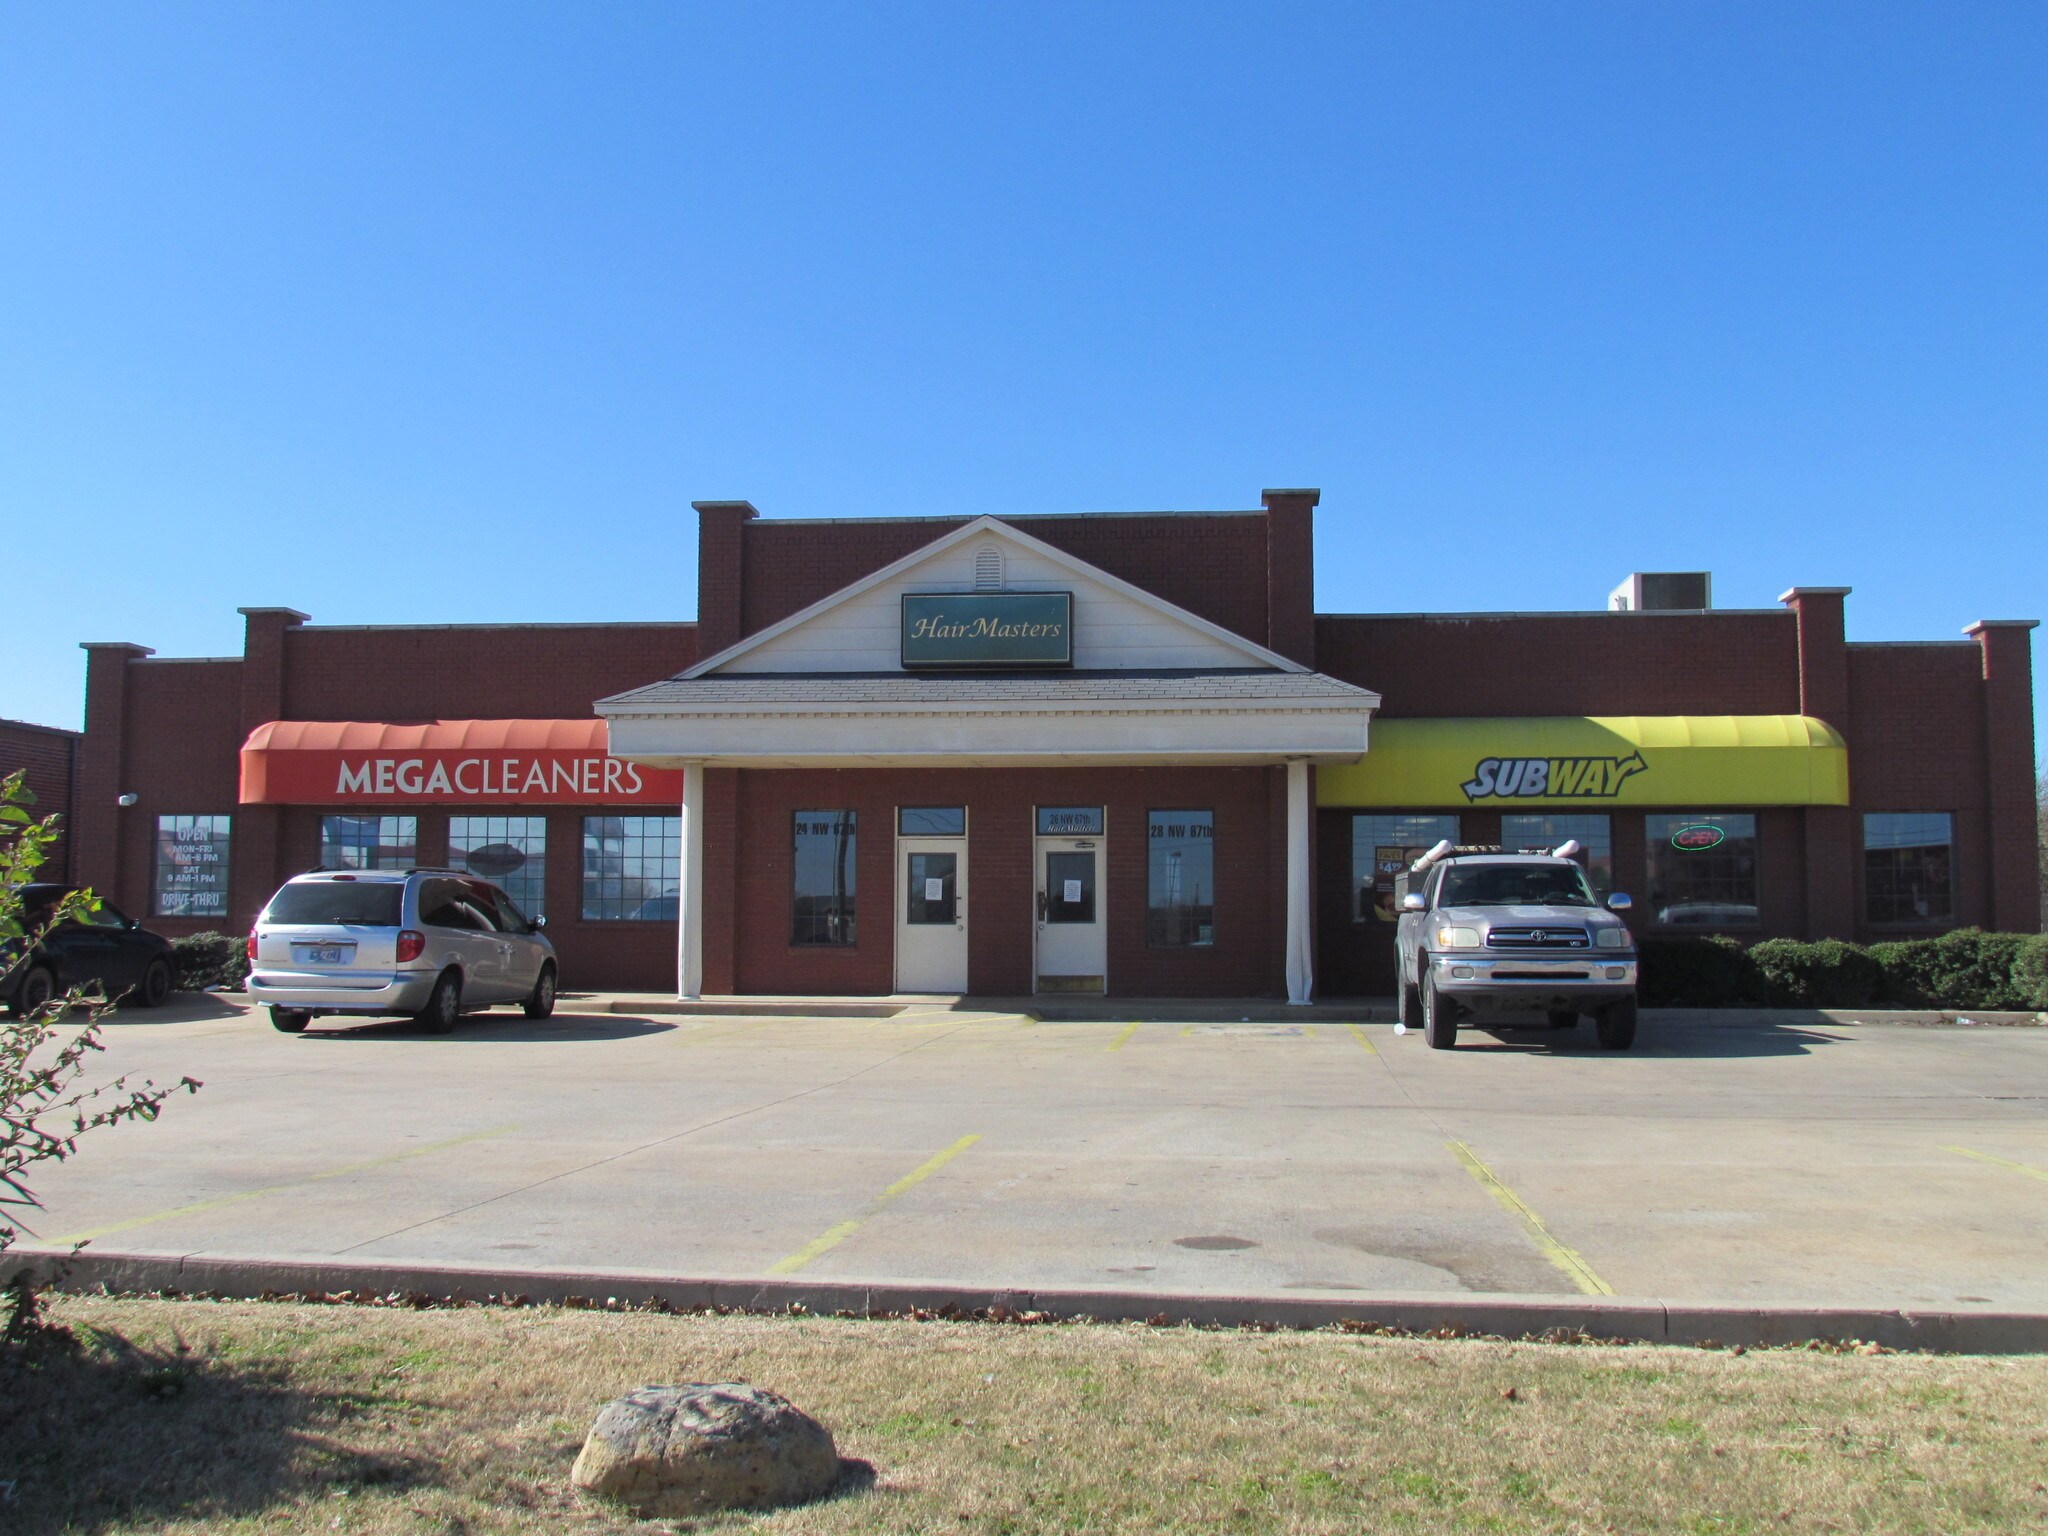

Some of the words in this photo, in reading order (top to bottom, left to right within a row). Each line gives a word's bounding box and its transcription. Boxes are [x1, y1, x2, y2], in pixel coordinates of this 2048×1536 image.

[1460, 750, 1648, 804] SUBWAY
[1050, 814, 1058, 824] 26
[1060, 814, 1073, 824] NW
[1074, 814, 1090, 824] 67th
[178, 826, 210, 841] OPEN
[796, 823, 807, 835] 24
[812, 823, 828, 835] NW
[1151, 825, 1163, 838] 28
[1168, 825, 1185, 838] NW
[1679, 831, 1718, 845] OPEN
[173, 845, 213, 853] MON-FRI
[203, 853, 218, 862] PM
[183, 866, 200, 874] SAT
[200, 874, 216, 882] PM
[162, 893, 219, 906] DRIVE-THRU
